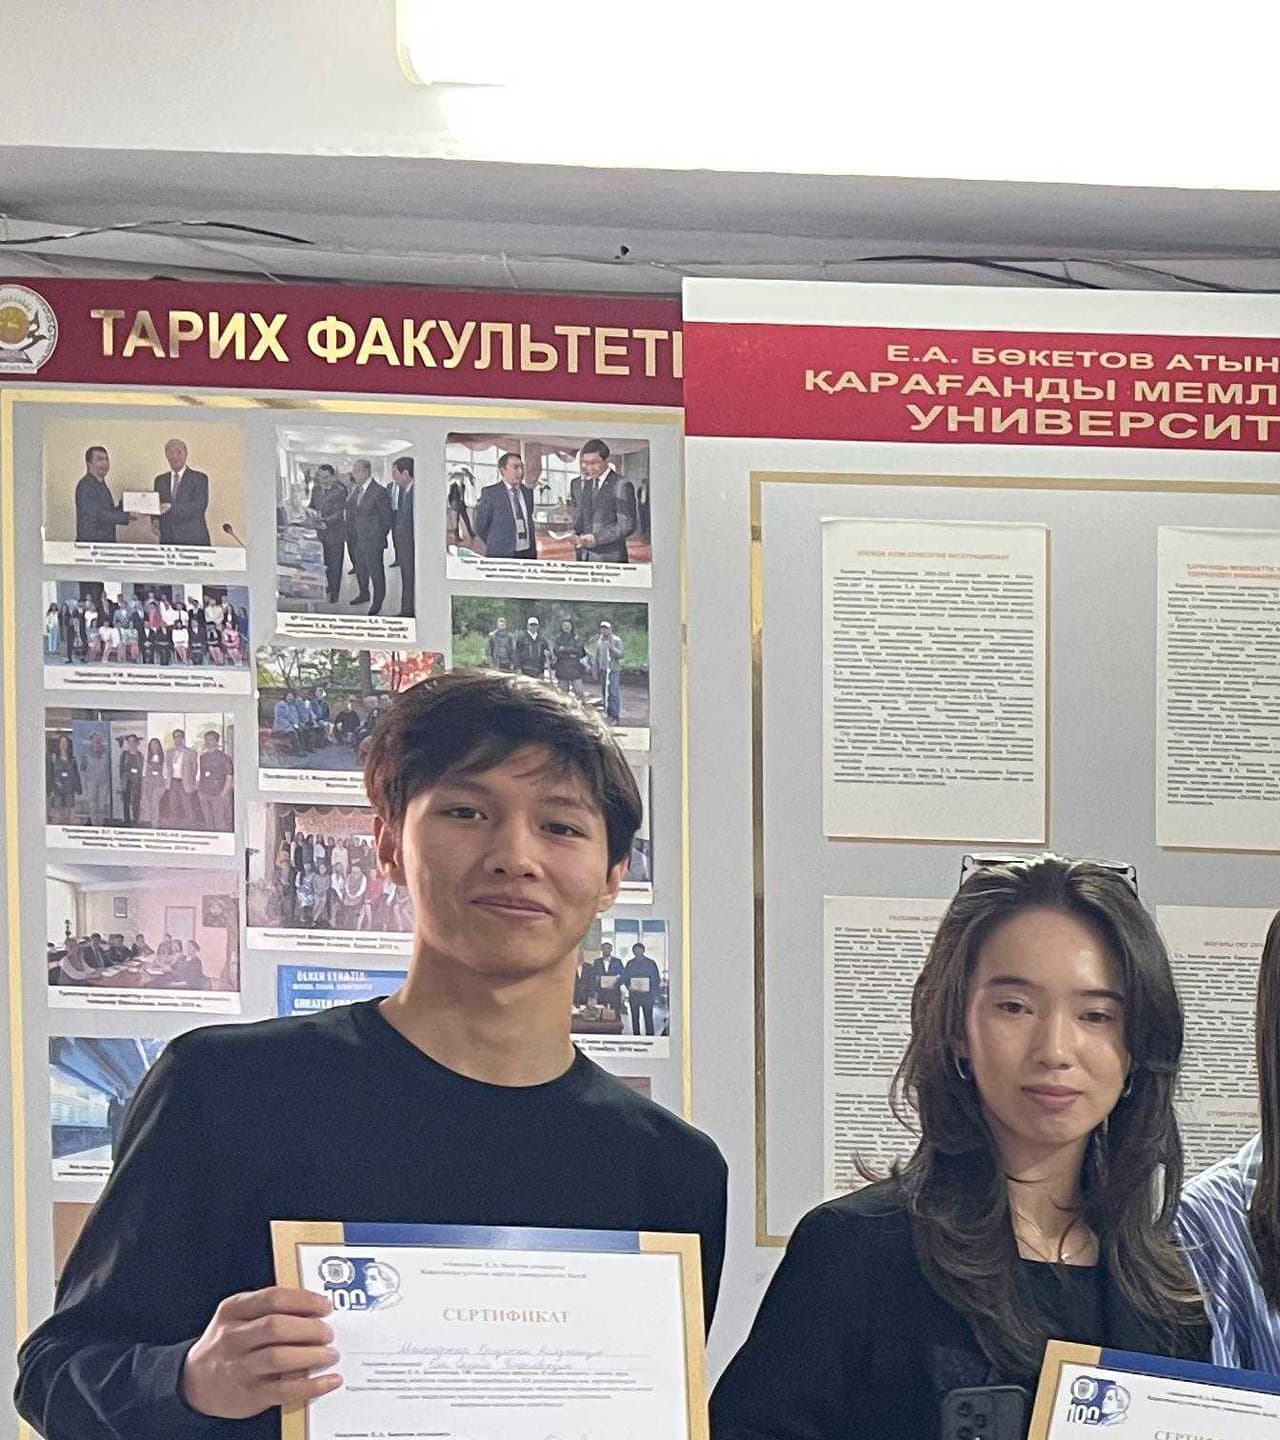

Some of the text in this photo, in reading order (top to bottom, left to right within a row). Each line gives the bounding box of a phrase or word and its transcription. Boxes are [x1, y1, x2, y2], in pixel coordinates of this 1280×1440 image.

[90, 308, 683, 377] ТАРИХ ФАКУЛЬТЕТІ
[886, 345, 959, 366] Е.А.
[972, 346, 1154, 371] БӨКЕТОВ
[804, 368, 1117, 403] ҚАРАҒАНДЫ
[443, 1307, 570, 1325] СЕРТИФИКАТ
